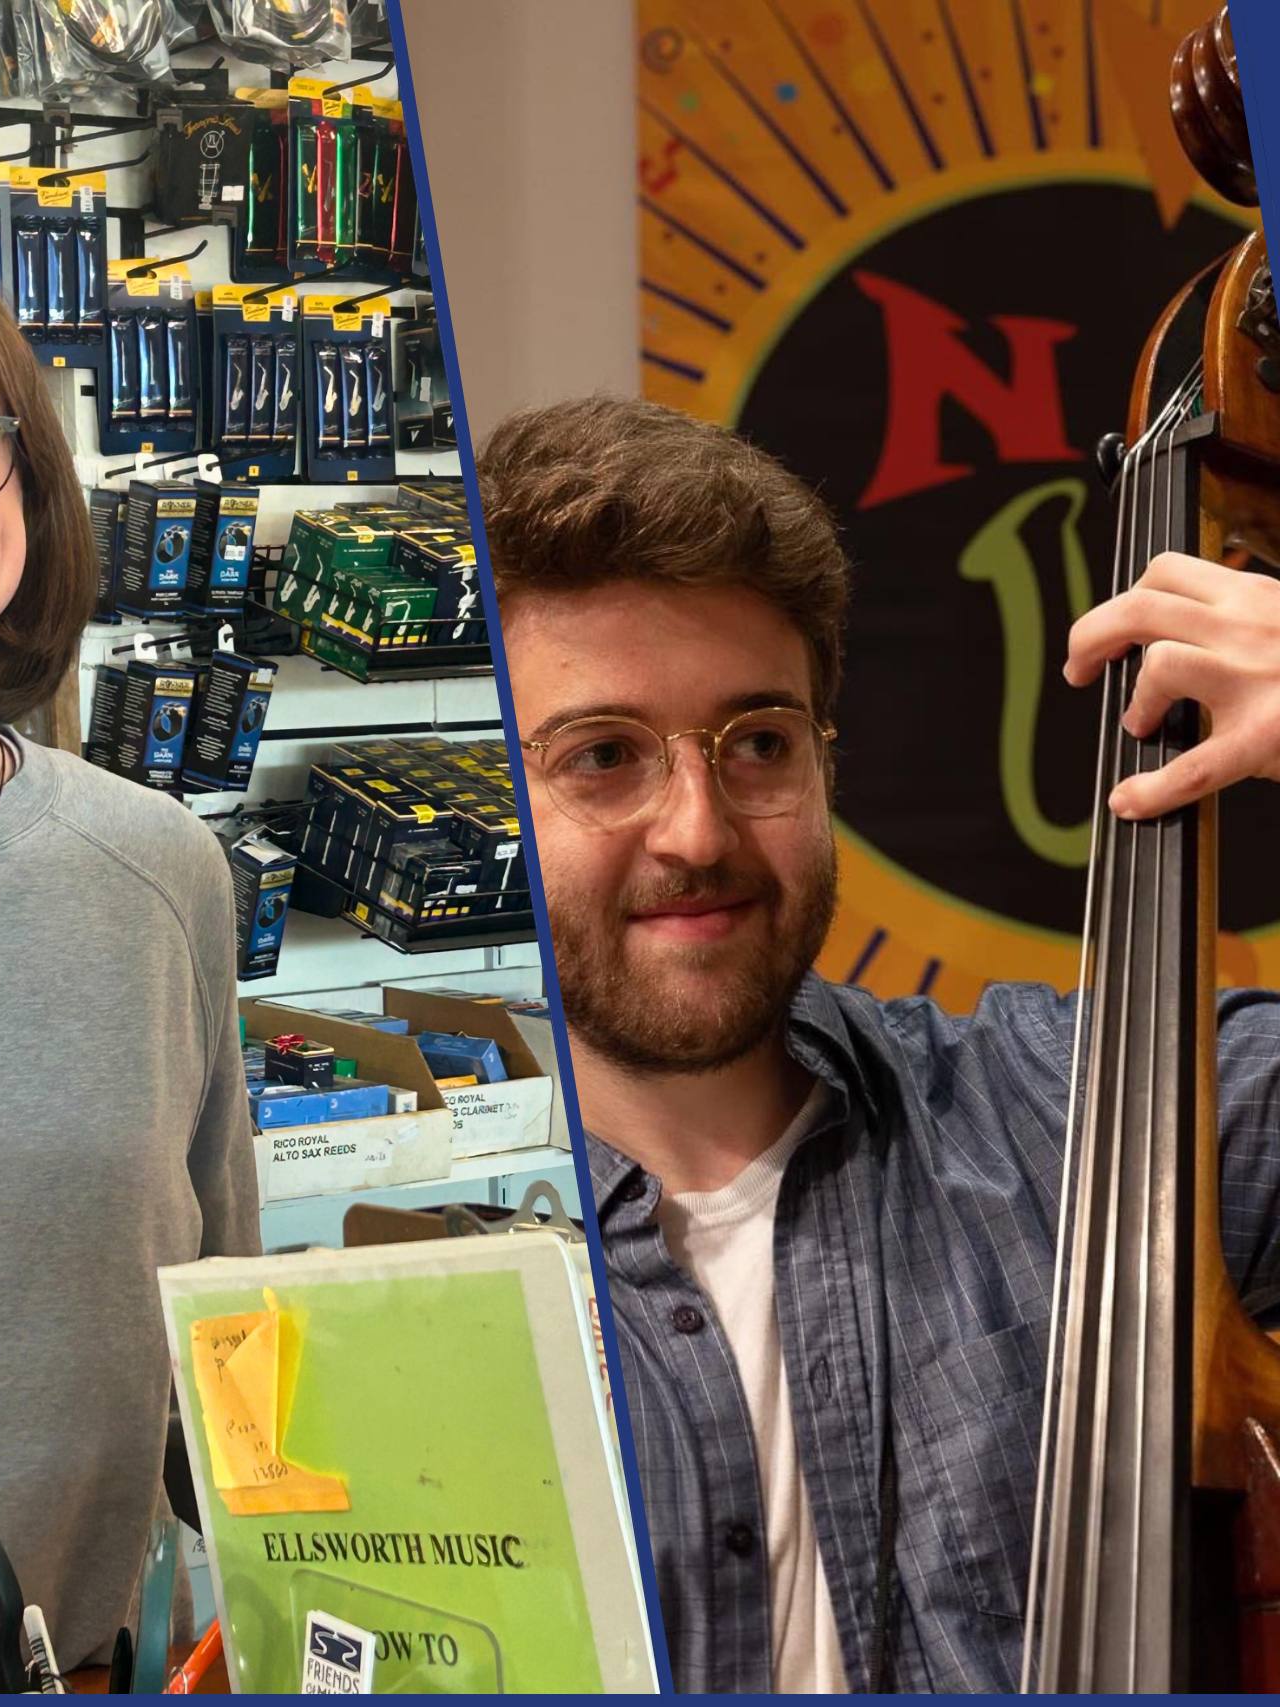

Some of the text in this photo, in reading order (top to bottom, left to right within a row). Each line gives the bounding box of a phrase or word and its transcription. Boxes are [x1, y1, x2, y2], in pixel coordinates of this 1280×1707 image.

[457, 1094, 486, 1104] ROYAL
[461, 1103, 504, 1116] CLARINET
[273, 1135, 329, 1149] RICO ROYAL
[273, 1144, 357, 1162] ALTO SAX REEDS
[263, 1532, 524, 1568] ELLSWORTH MUSIC
[373, 1629, 458, 1667] OW TO
[307, 1657, 360, 1694] FRIENDS
